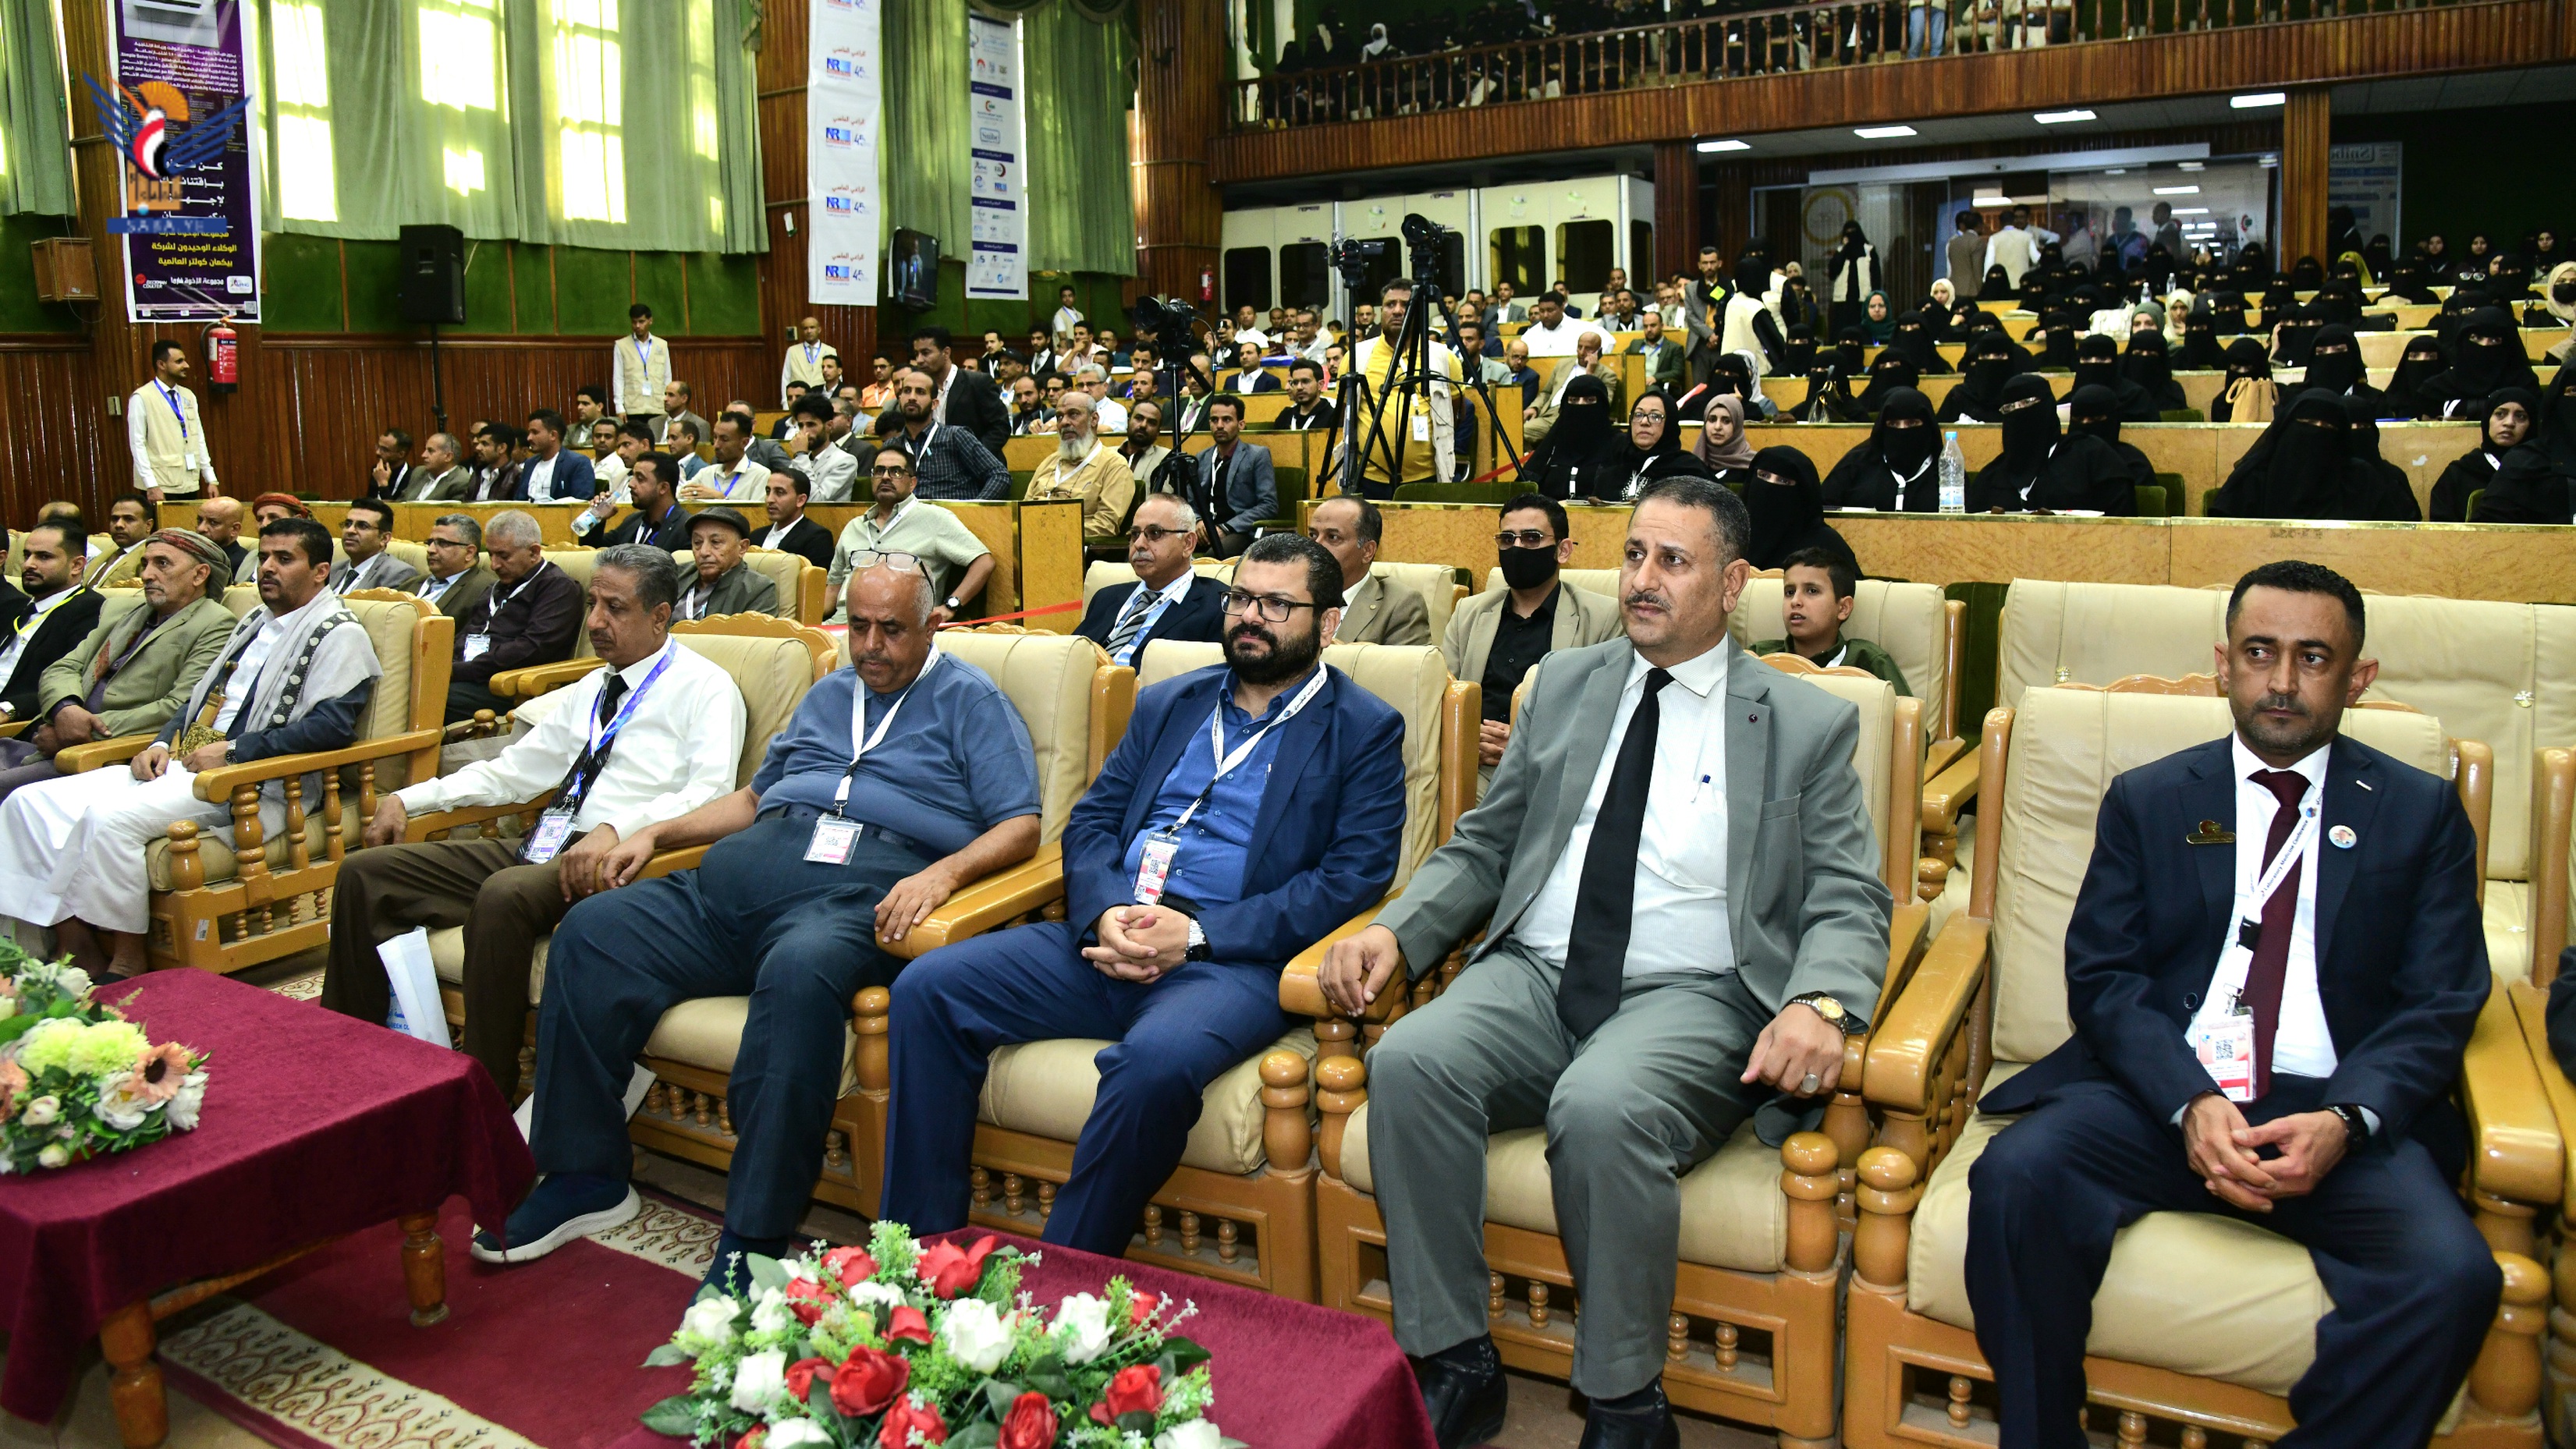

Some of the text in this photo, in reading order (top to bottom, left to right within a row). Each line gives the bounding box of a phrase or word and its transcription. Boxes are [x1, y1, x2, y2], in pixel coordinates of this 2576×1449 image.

[827, 197, 839, 209] NR
[151, 242, 237, 253] الوكلاء الوحيدون لشركة
[188, 258, 208, 267] كولتر
[825, 265, 839, 278] NR
[2264, 820, 2308, 891] Laboratory Medicine Conference
